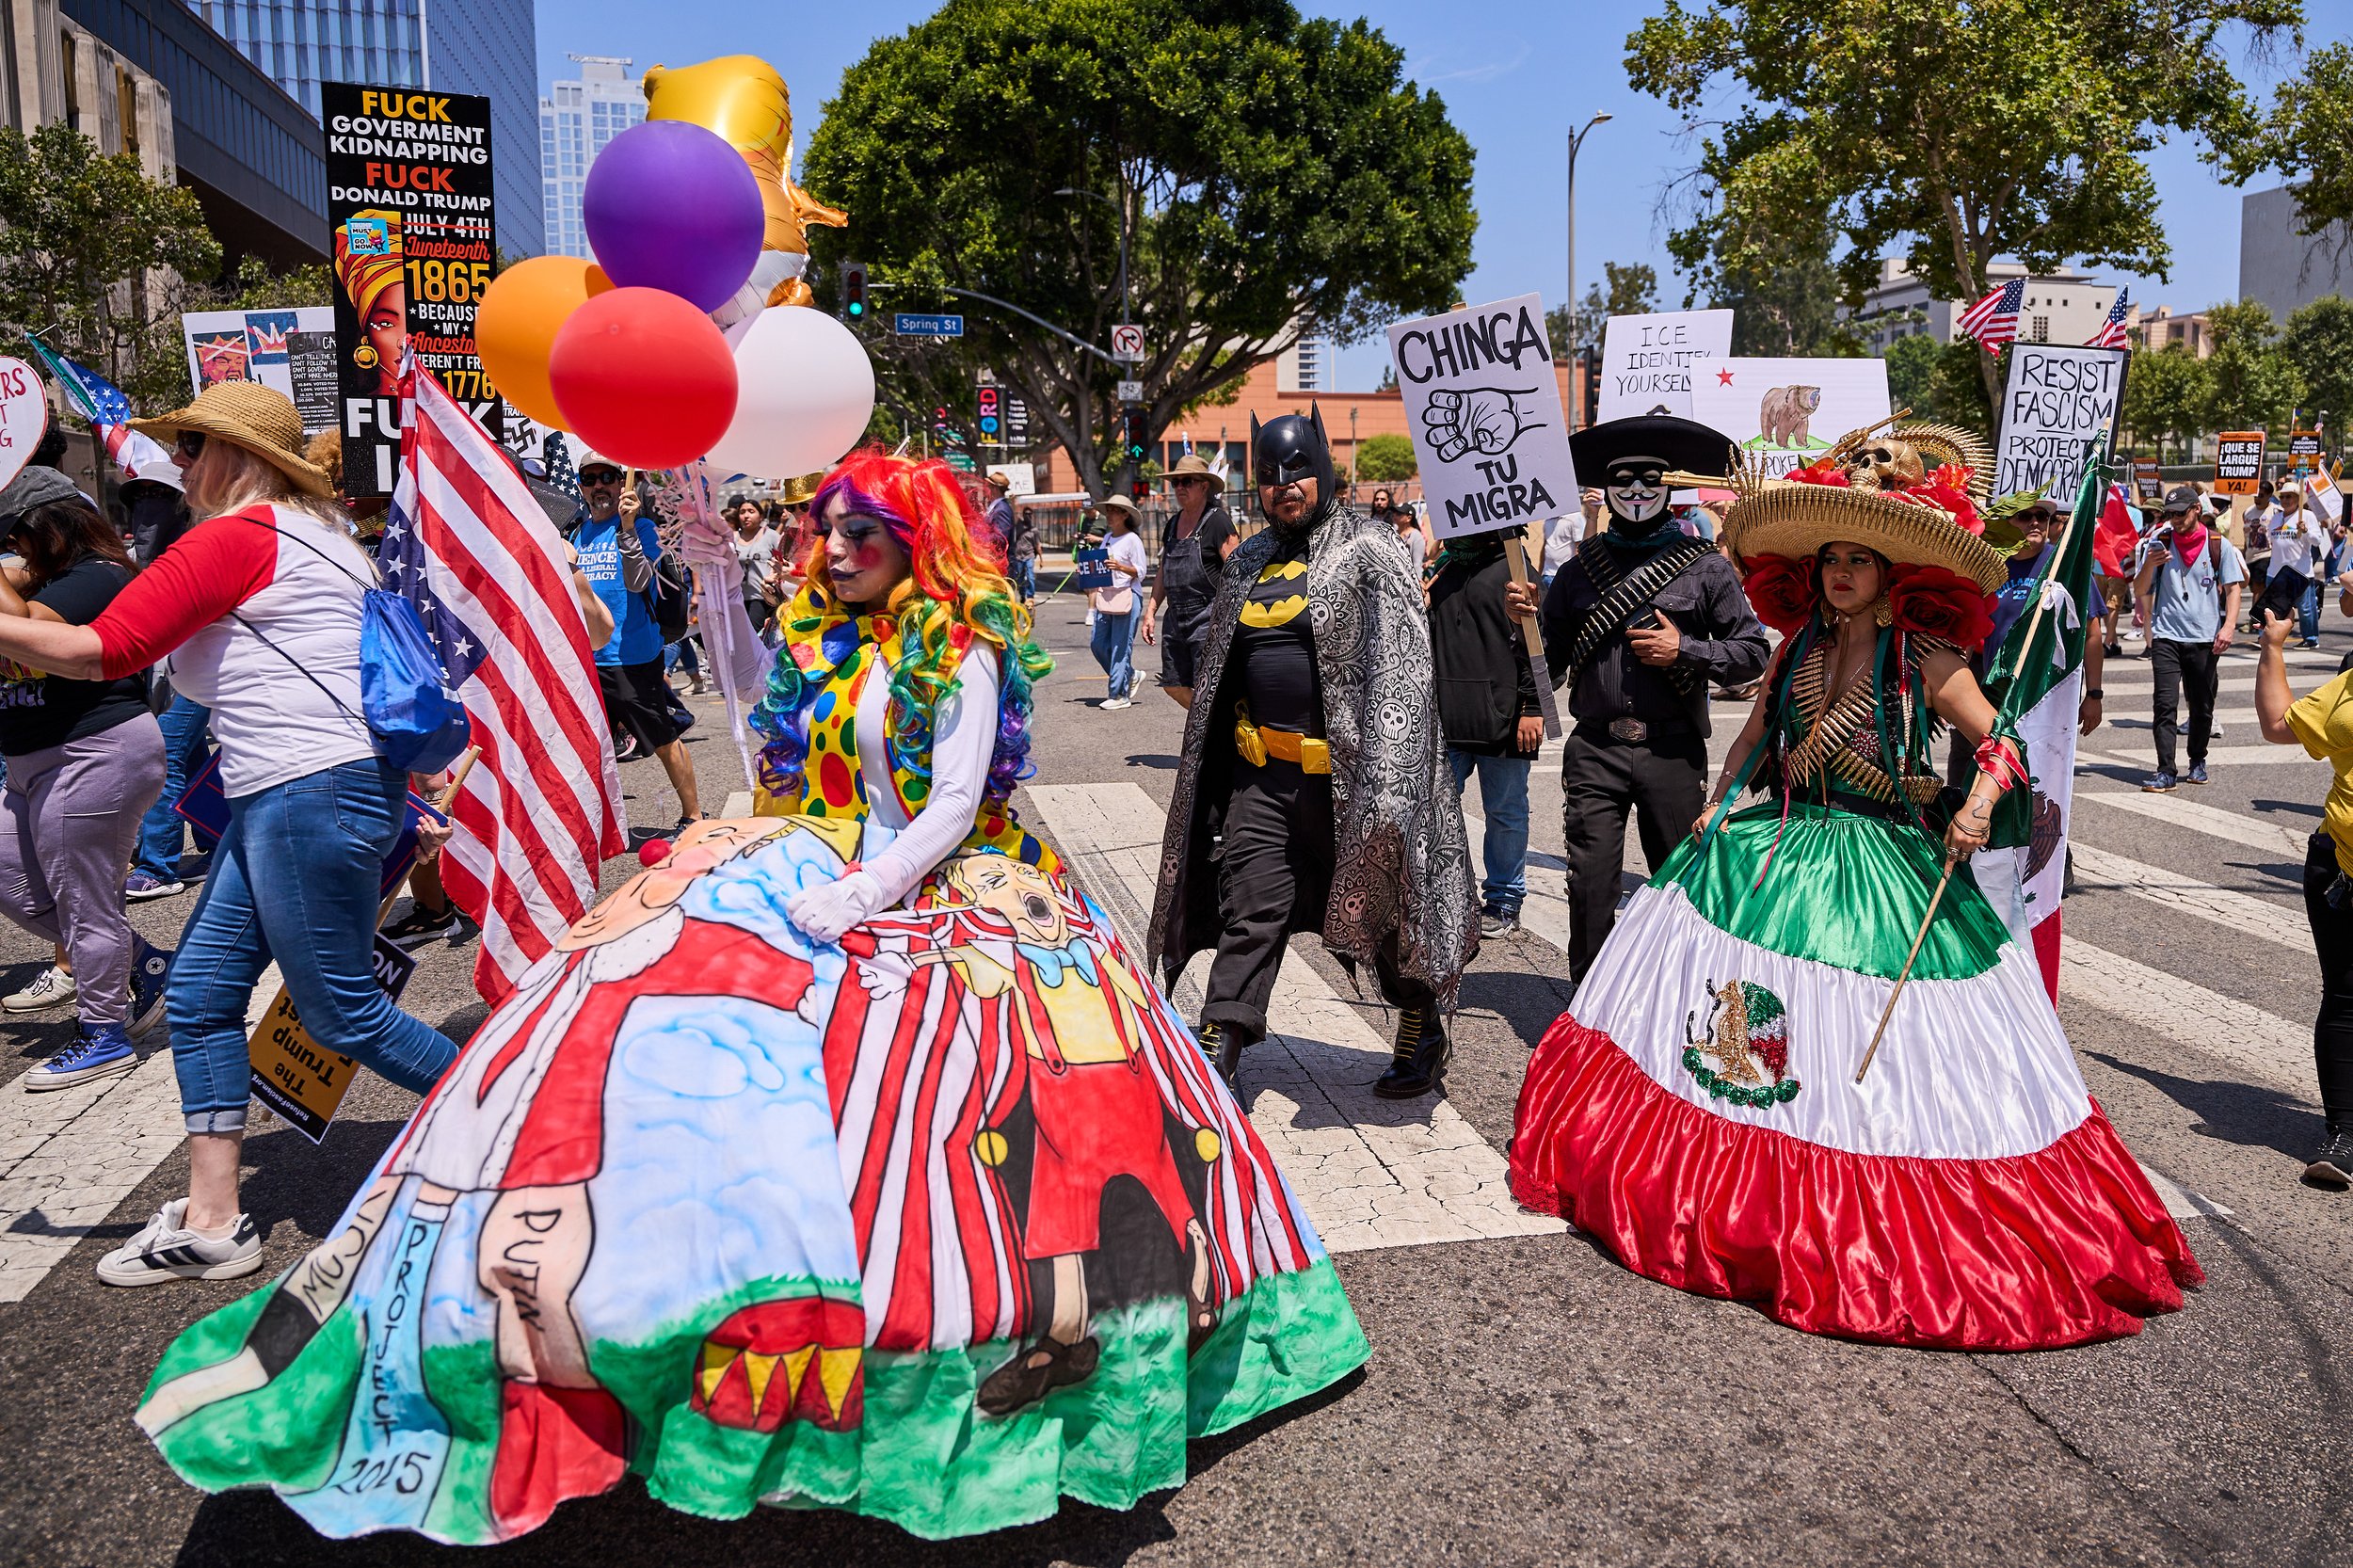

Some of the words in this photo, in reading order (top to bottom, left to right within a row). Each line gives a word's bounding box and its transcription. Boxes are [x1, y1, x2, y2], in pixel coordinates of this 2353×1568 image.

[362, 90, 452, 122] FUCK
[331, 115, 484, 144] GOVERMENT
[329, 136, 488, 165] KIDNAPPING
[365, 162, 456, 192] FUCK
[331, 185, 419, 206] DONALD
[422, 193, 491, 212] TRUMP
[404, 213, 448, 237] JULY
[455, 216, 490, 240] 4TH
[405, 235, 490, 261] Juneteenth
[406, 260, 492, 304] 1865
[442, 322, 459, 335] MY
[902, 317, 939, 332] Spring
[943, 319, 957, 330] St
[411, 331, 477, 355] Ancesto
[1398, 305, 1550, 384] CHINGA
[466, 356, 484, 370] FR
[2021, 353, 2118, 394] RESIST
[442, 370, 496, 399] 1776
[345, 397, 497, 440] FUK
[2012, 391, 2113, 431] FASCISM
[2009, 435, 2094, 460] PROTECT
[2218, 454, 2259, 466] LARGUE
[2220, 442, 2245, 455] ¡QUE
[2246, 442, 2261, 454] SE
[1475, 453, 1518, 487] TU
[1998, 456, 2085, 503] DEMOCRA
[2219, 465, 2257, 477] TRUMP
[2227, 481, 2247, 492] YA!
[1445, 477, 1557, 529] MIGRA
[272, 1026, 337, 1088] Trump
[274, 1062, 306, 1097] The
[250, 1073, 310, 1122] RefuseFascism.org
[503, 1208, 563, 1333] PUTIN
[373, 1224, 428, 1448] PROJECT
